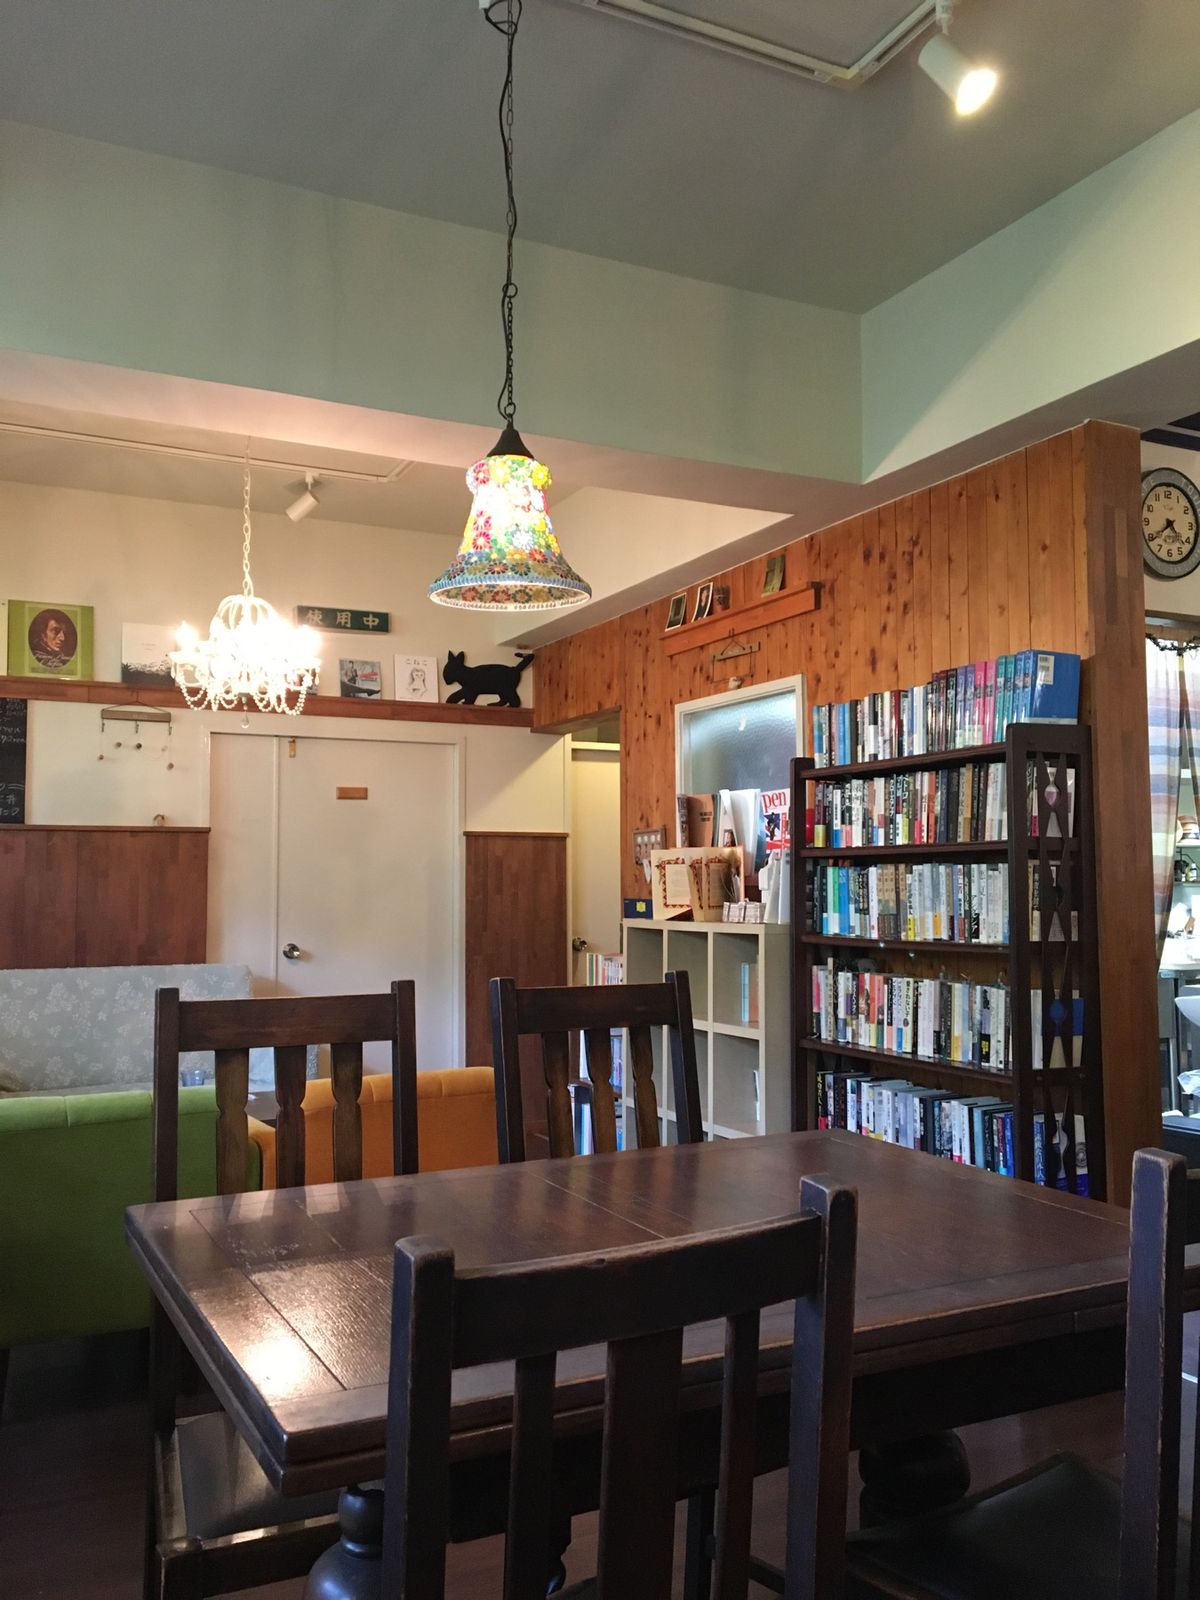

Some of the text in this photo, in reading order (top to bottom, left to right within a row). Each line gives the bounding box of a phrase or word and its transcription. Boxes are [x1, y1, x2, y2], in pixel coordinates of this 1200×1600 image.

[1154, 493, 1160, 502] 11
[1164, 490, 1172, 499] 12
[1176, 495, 1180, 504] 1
[1146, 505, 1154, 513] 10
[1183, 506, 1189, 515] 2
[1143, 518, 1150, 526] 9
[1188, 522, 1194, 531] 3
[1147, 533, 1154, 542] 8
[1184, 536, 1191, 545] 4
[1157, 544, 1163, 553] 7
[1166, 549, 1173, 557] 6
[1177, 547, 1183, 556] 5
[306, 609, 380, 629] 使用中
[405, 658, 429, 666] こねこ
[762, 791, 787, 813] pen
